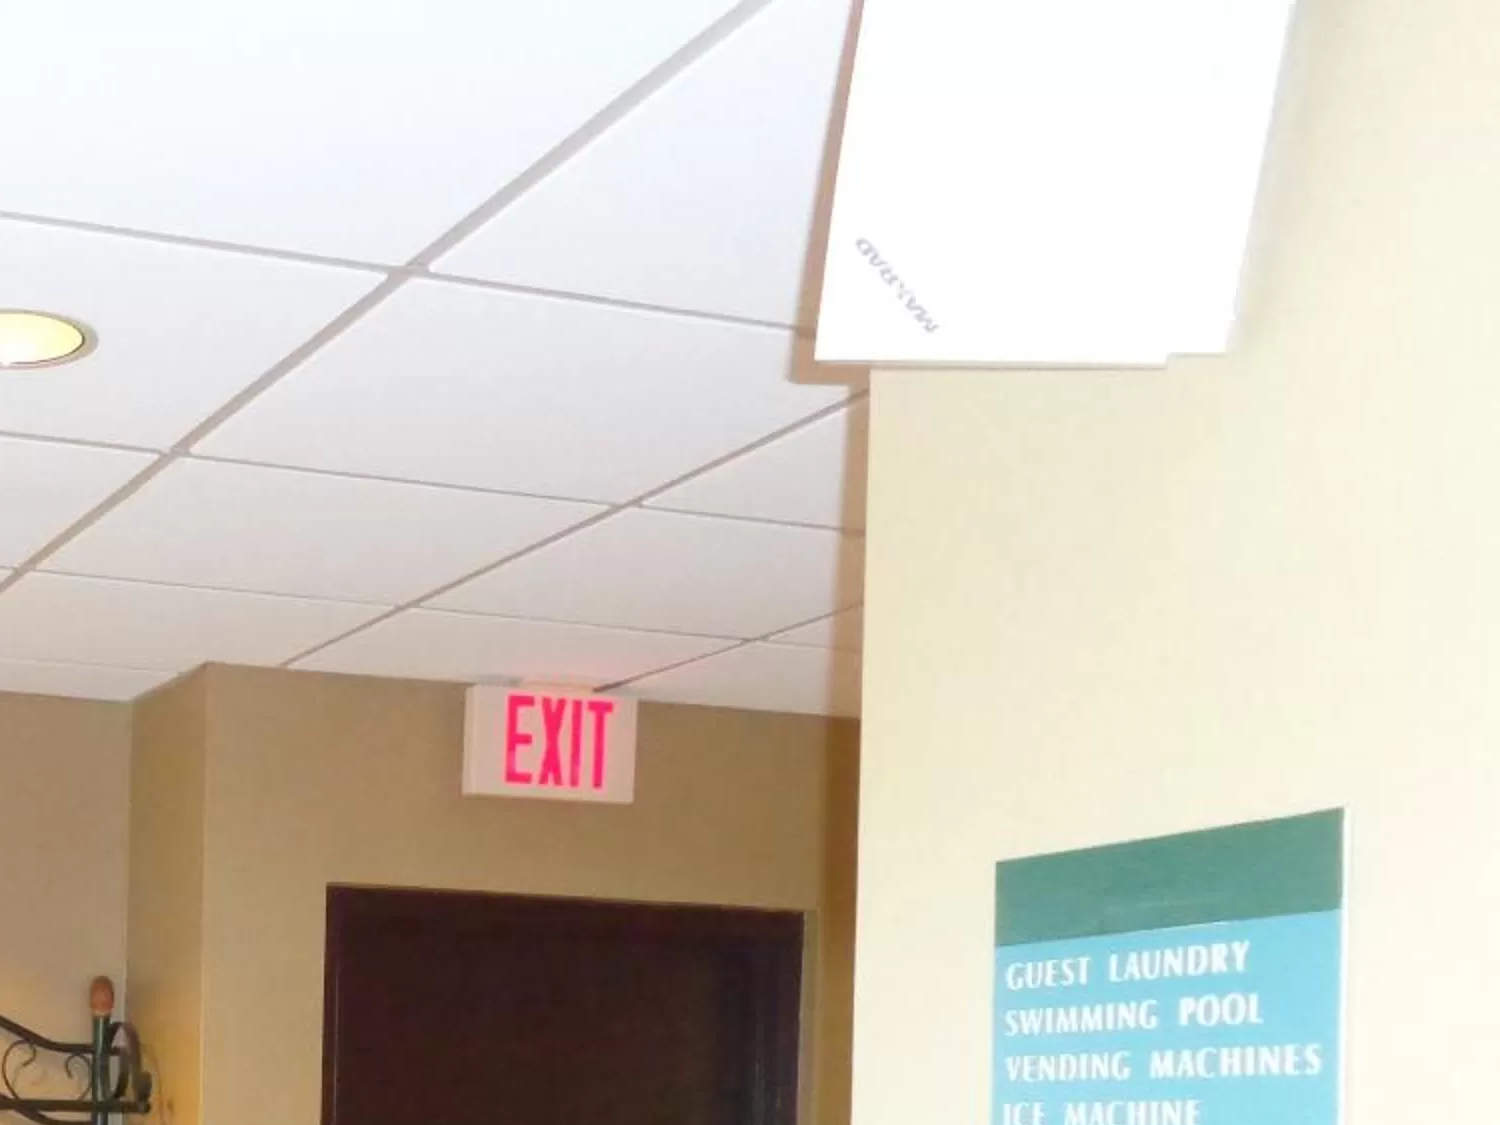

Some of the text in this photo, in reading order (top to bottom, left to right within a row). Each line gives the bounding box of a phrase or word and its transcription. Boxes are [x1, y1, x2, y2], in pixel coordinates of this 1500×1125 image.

[505, 694, 613, 789] EXIT
[1006, 940, 1251, 991] GUEST LAUNDRY
[1004, 992, 1264, 1037] SWIMMING POOL
[1005, 1043, 1323, 1082] VENDING MACHINES
